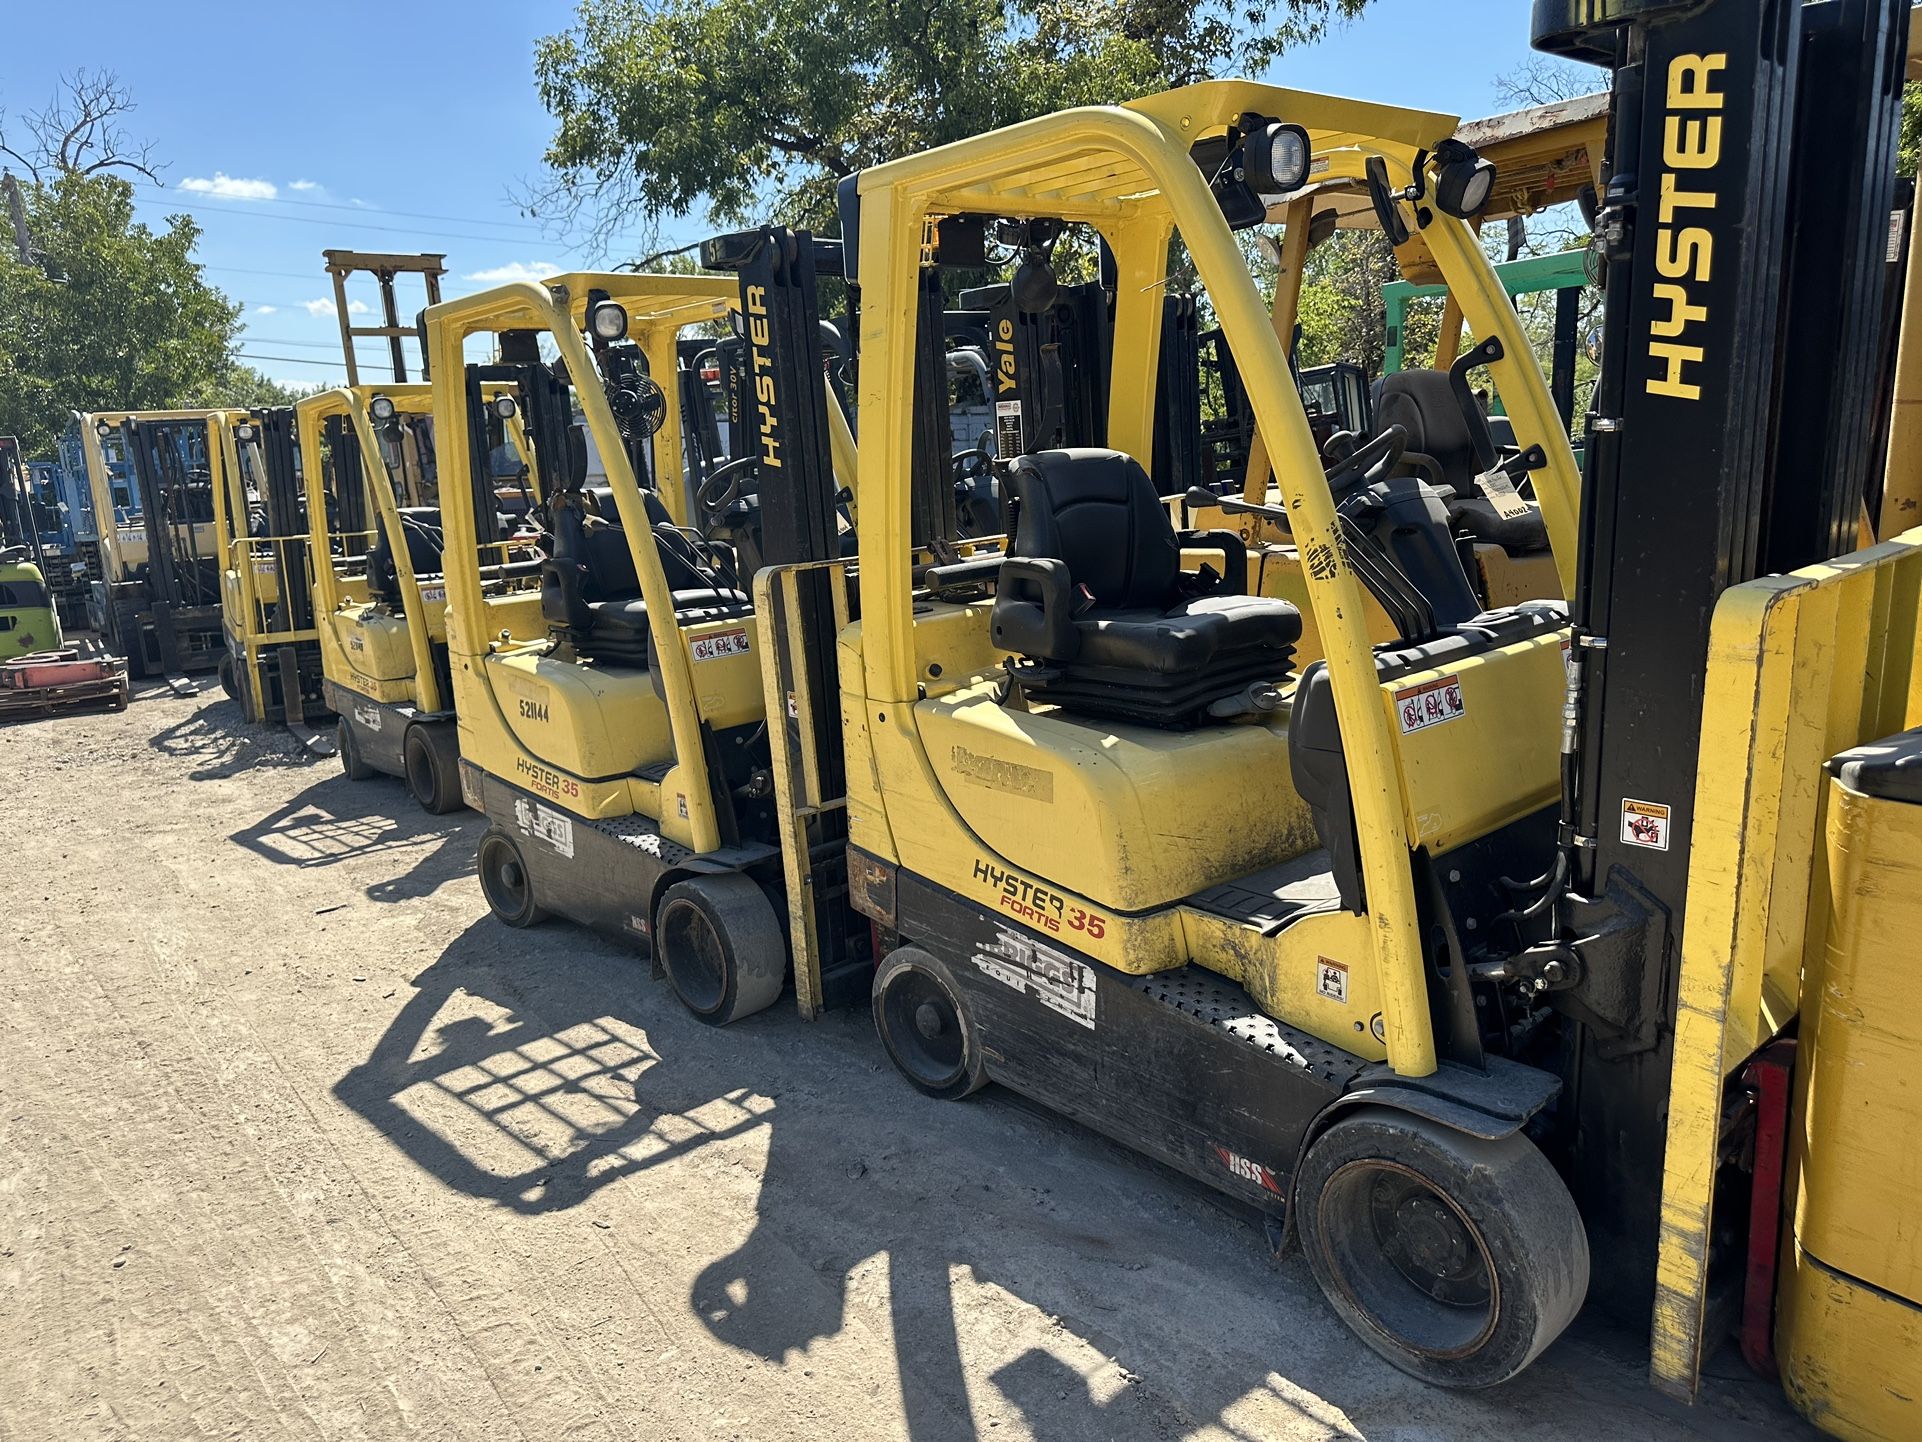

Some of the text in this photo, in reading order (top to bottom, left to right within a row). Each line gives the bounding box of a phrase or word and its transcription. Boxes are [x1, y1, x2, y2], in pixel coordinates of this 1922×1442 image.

[1645, 53, 1727, 401] HYSTER
[746, 284, 782, 467] HYSTER
[995, 319, 1017, 394] Yale
[519, 699, 550, 723] 521144
[516, 756, 579, 798] HYSTER 35
[531, 779, 560, 800] FORTIS
[1636, 806, 1665, 815] WARNING
[973, 859, 1106, 939] HYSTER 35
[1000, 895, 1061, 933] FORTIS
